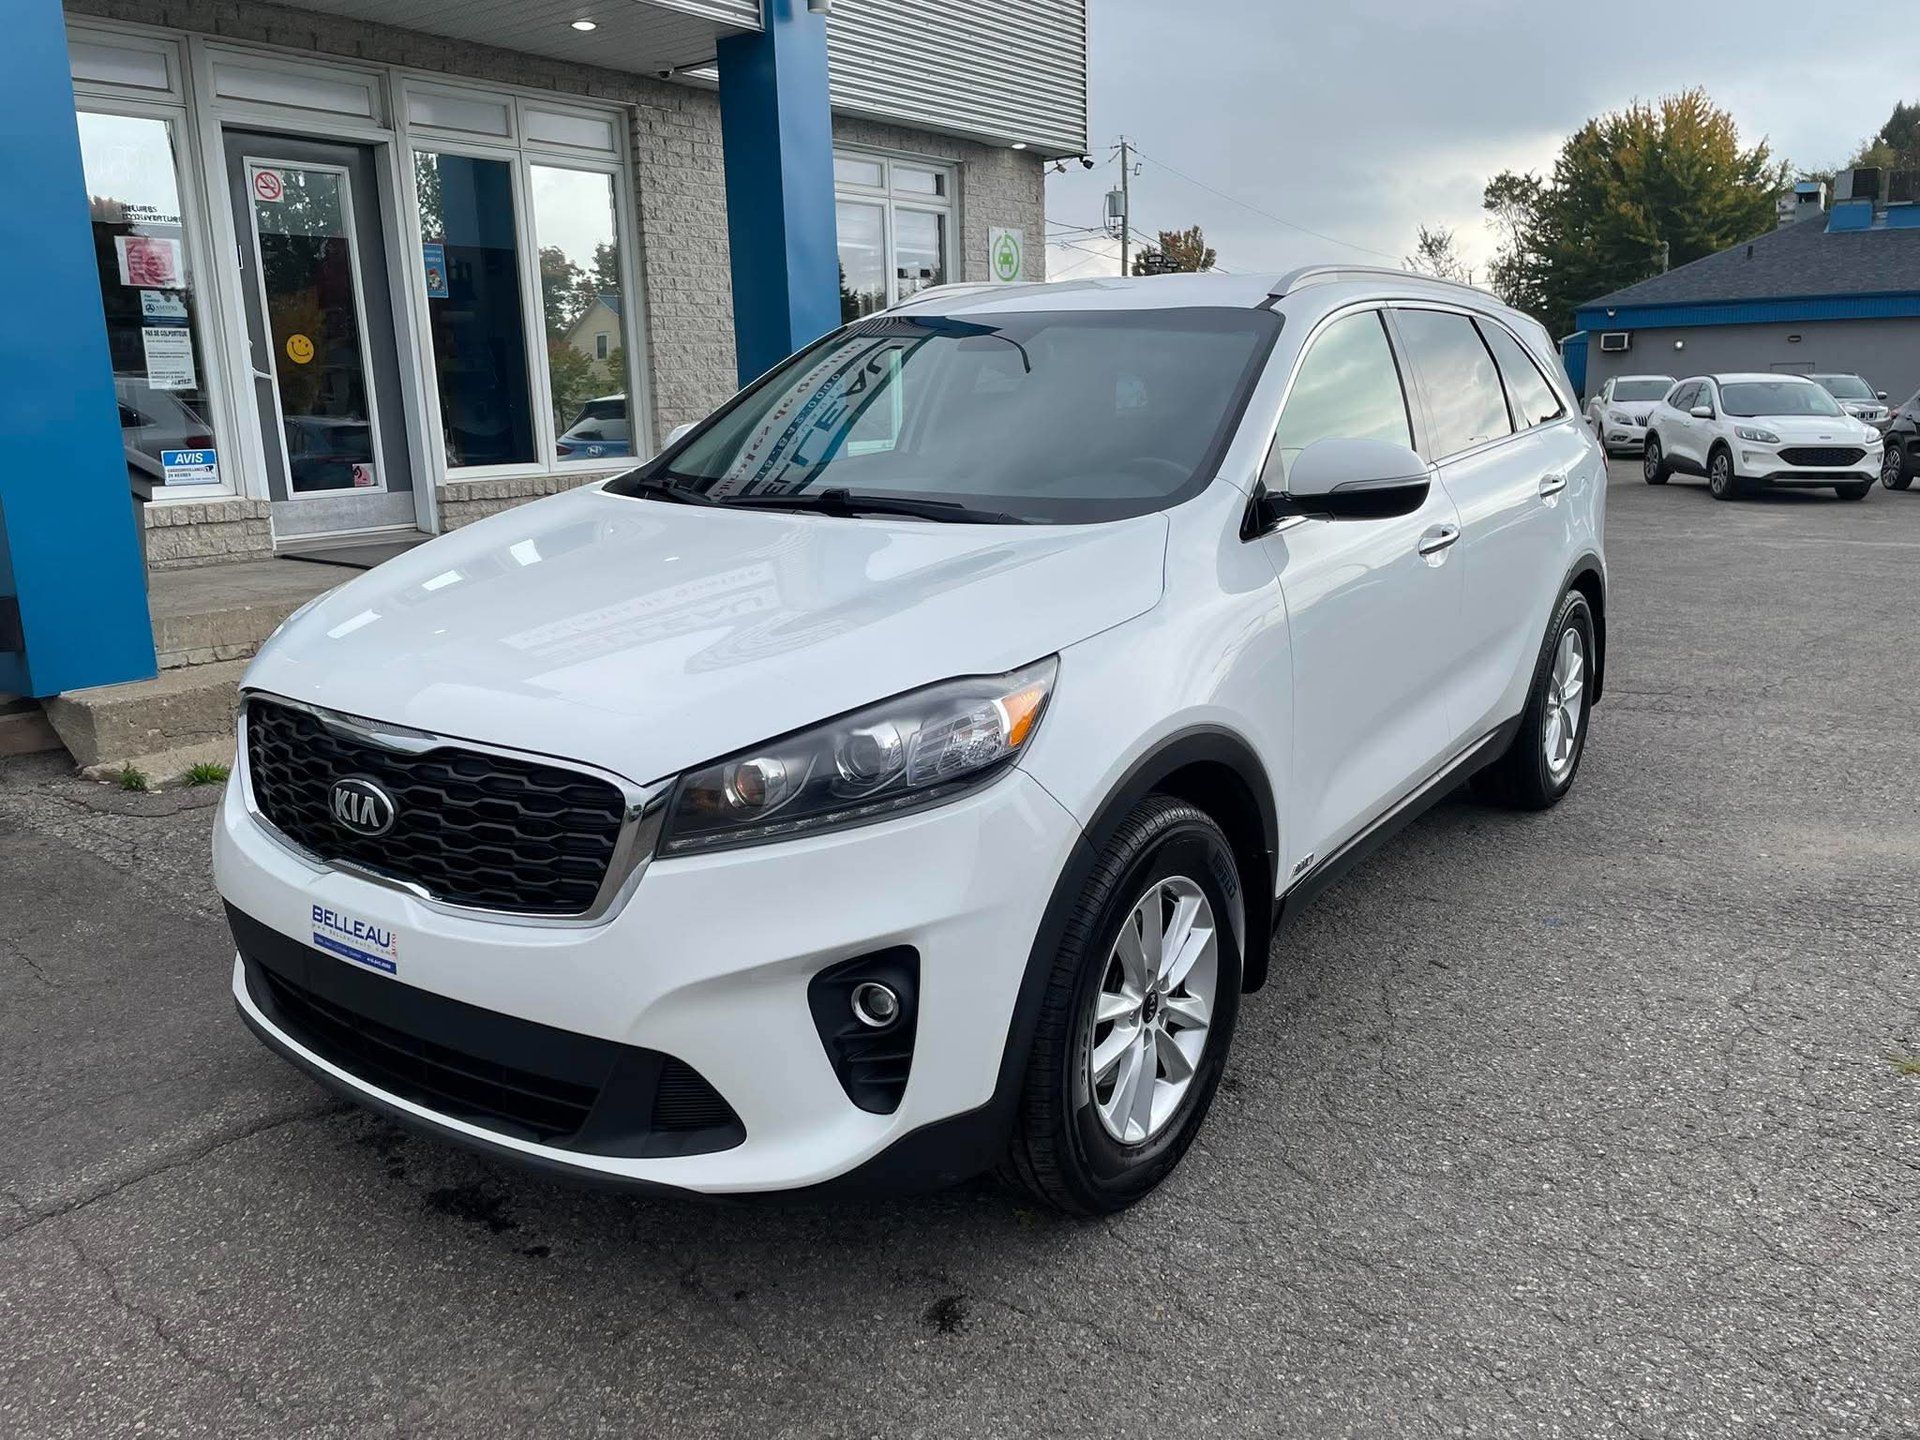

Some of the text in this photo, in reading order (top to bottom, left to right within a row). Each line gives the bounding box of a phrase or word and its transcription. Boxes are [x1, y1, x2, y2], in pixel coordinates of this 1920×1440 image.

[174, 452, 204, 464] AVIS
[335, 787, 380, 827] KIA
[312, 904, 391, 948] BELLEAU
